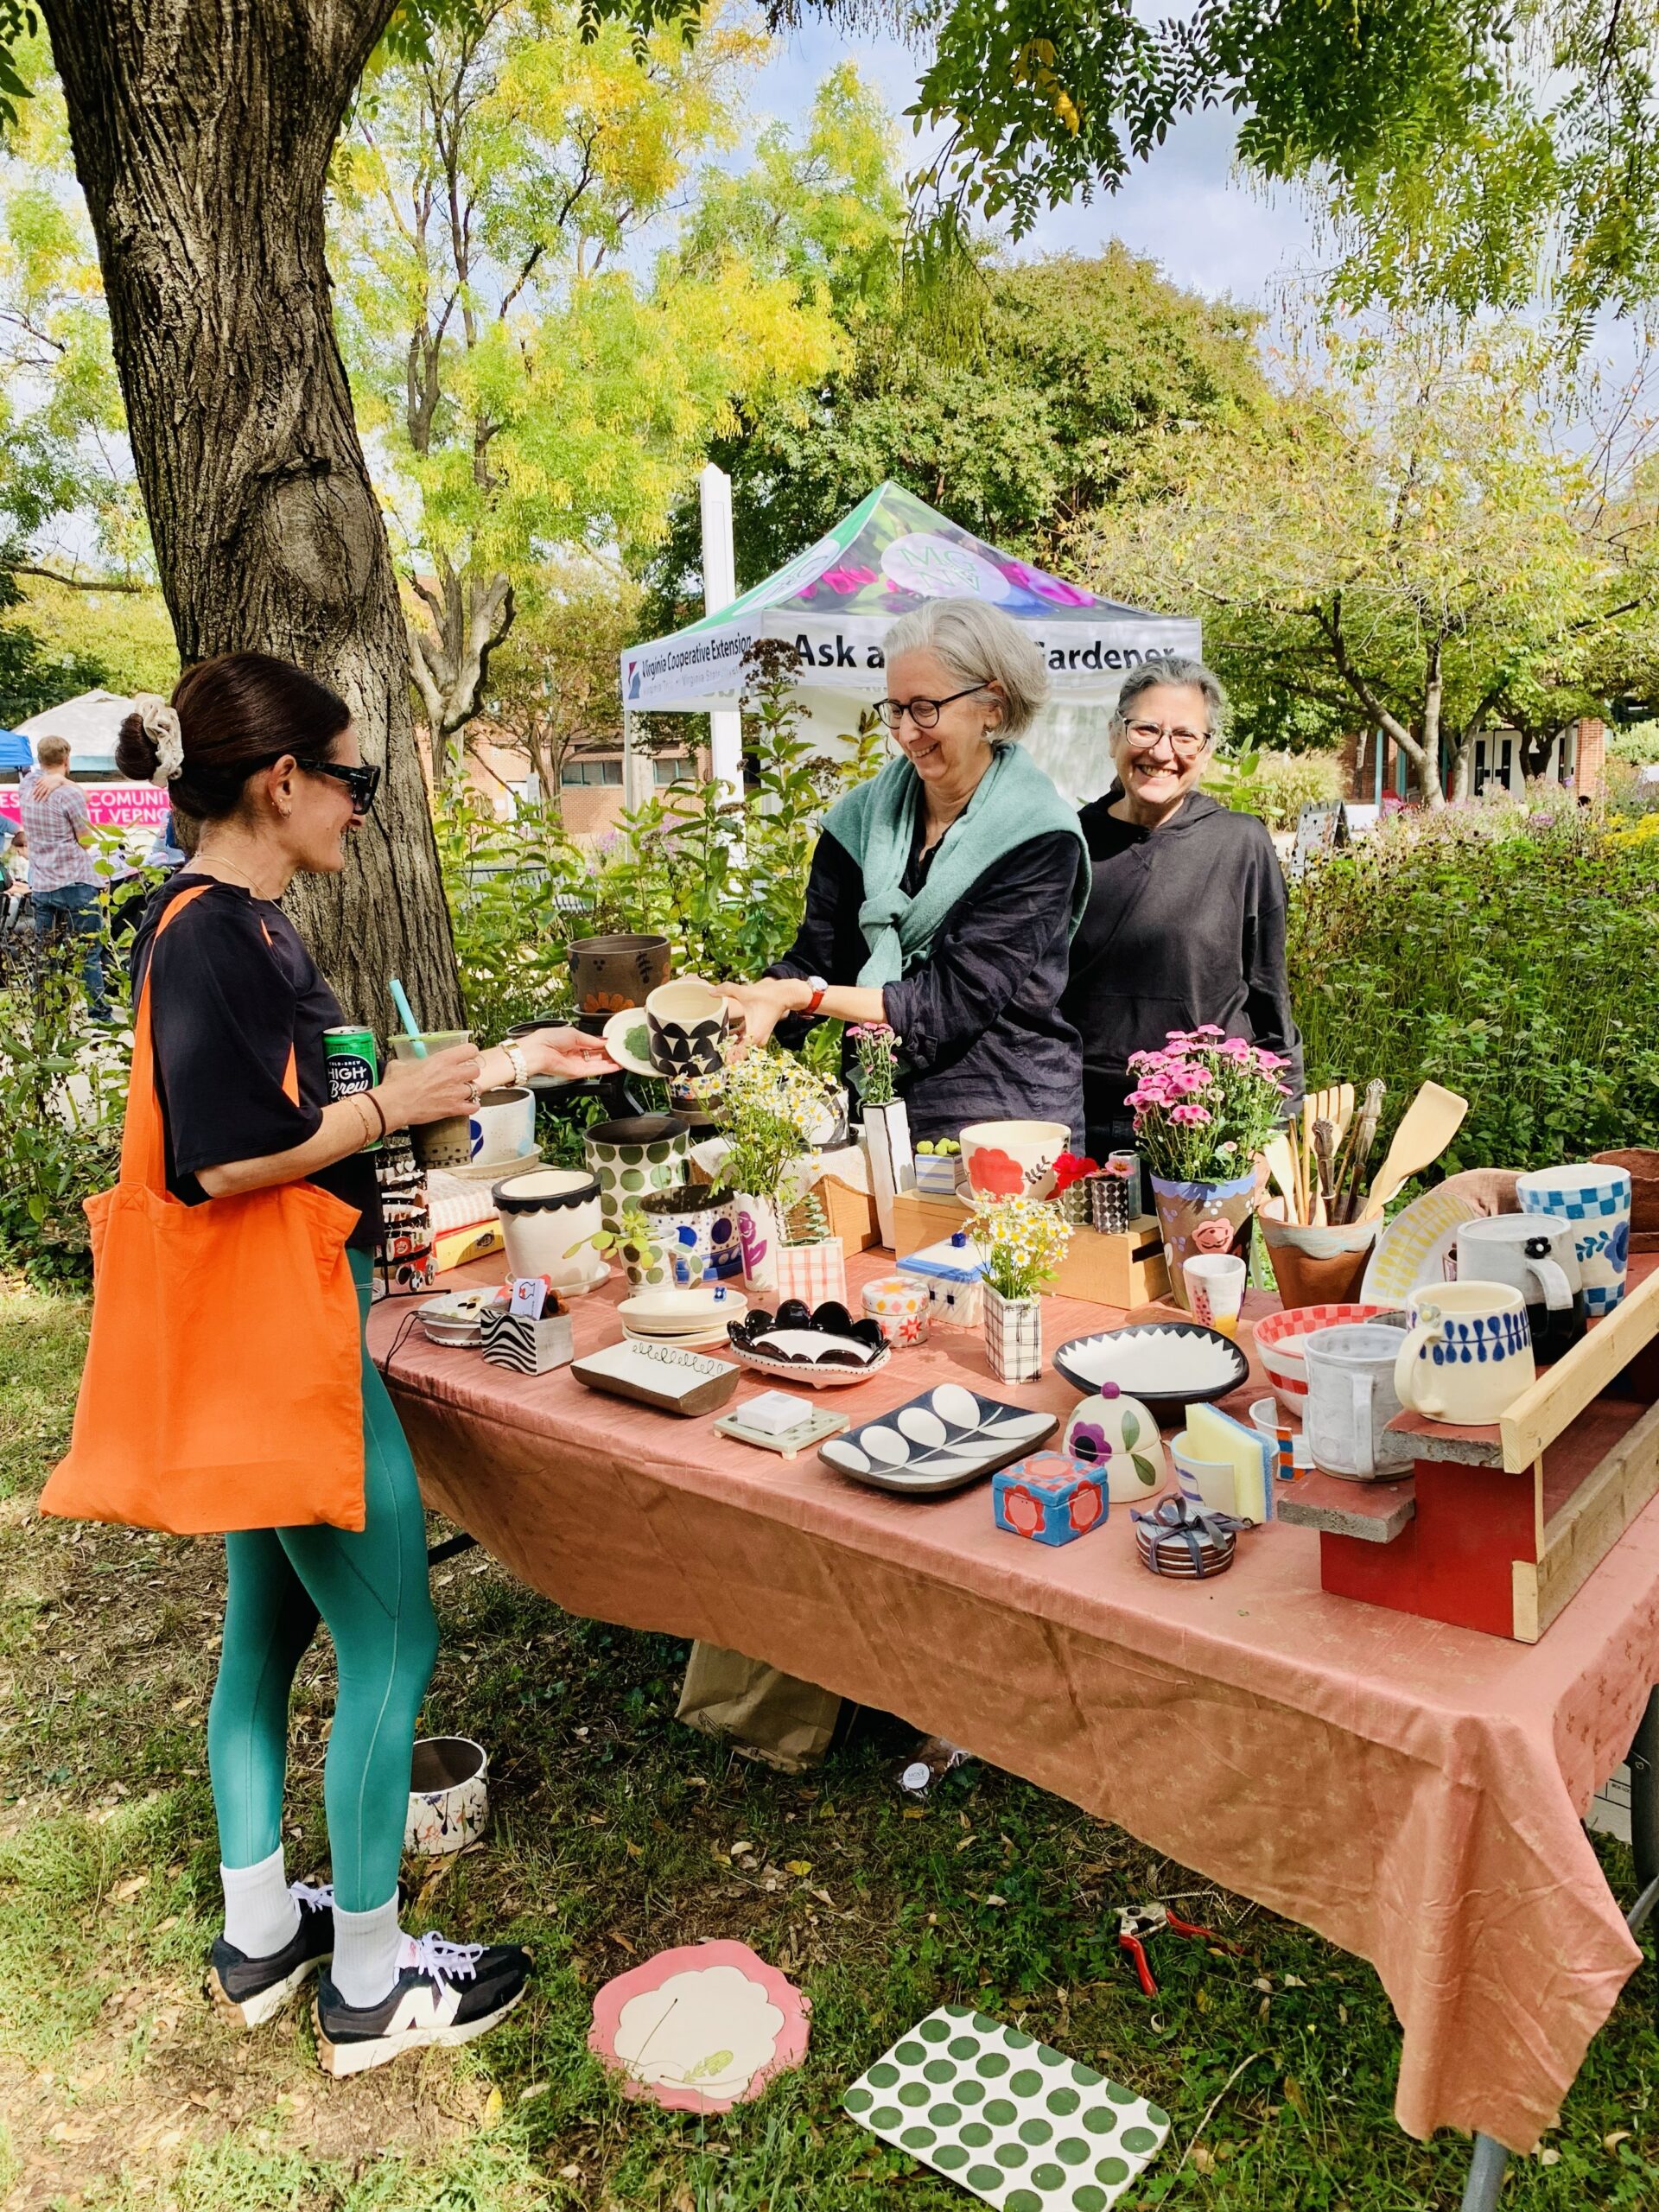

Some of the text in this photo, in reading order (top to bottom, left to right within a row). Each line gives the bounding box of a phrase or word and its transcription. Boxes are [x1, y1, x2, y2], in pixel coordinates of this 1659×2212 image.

[642, 656, 667, 681] Virginia
[667, 643, 711, 671] Cooperative
[710, 632, 752, 660] Extension
[795, 633, 1175, 671] Ask a ardener
[327, 1066, 367, 1080] HIGH
[328, 1079, 369, 1098] Brew
